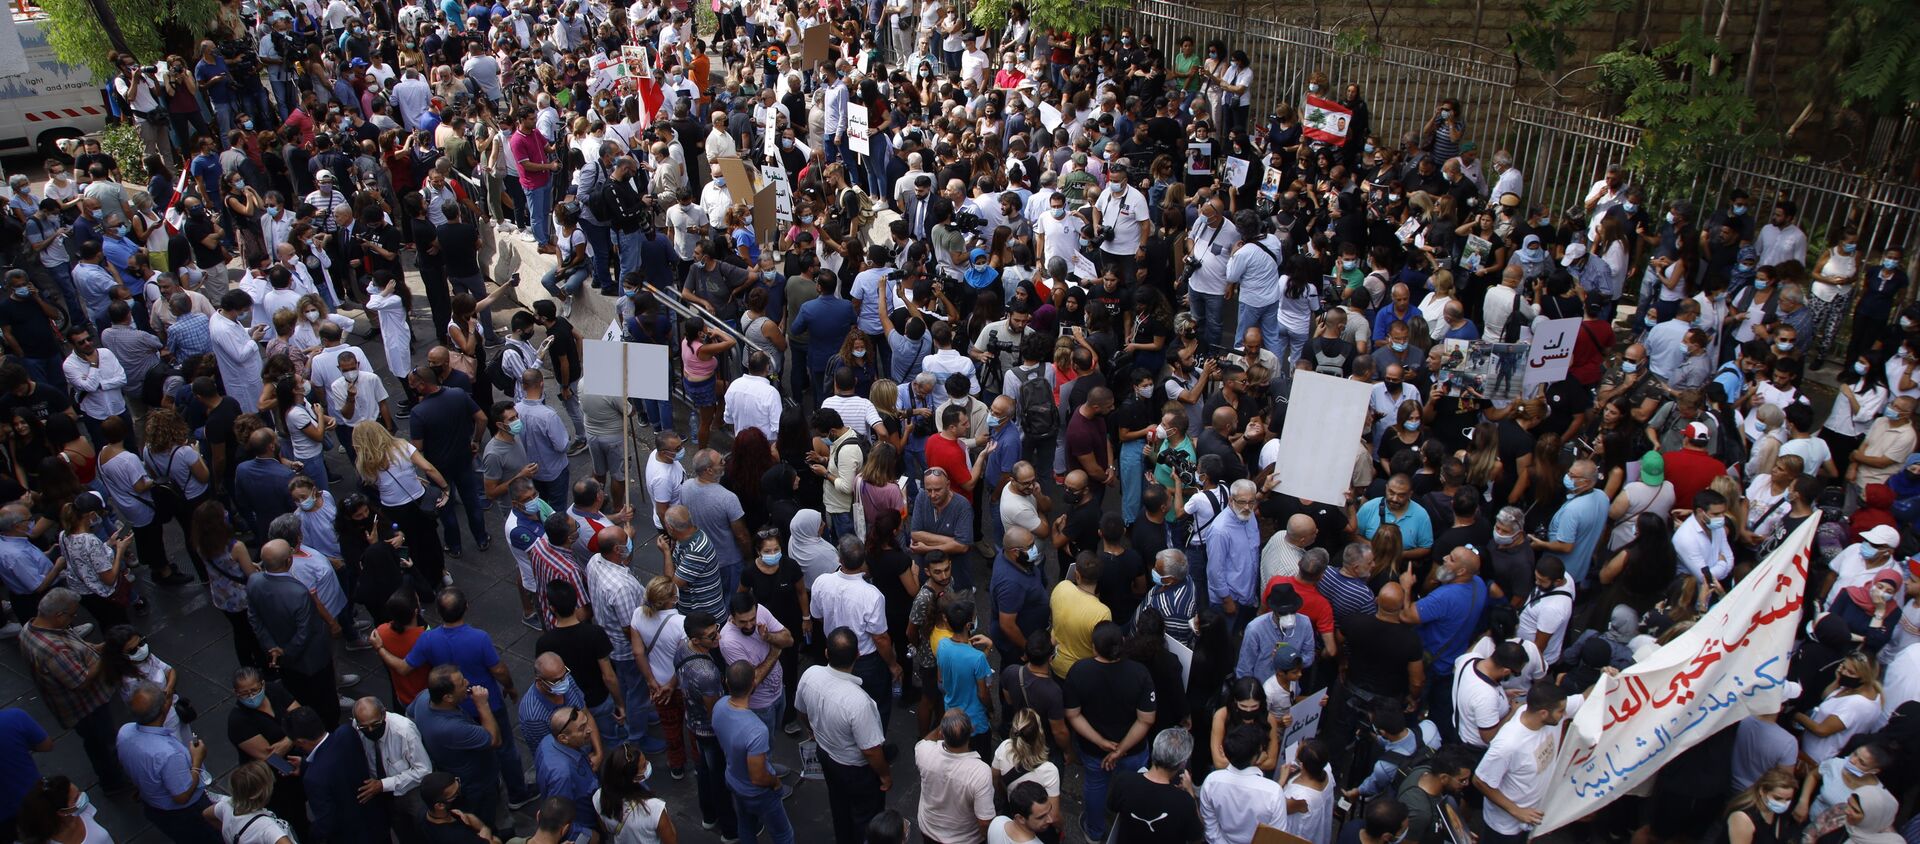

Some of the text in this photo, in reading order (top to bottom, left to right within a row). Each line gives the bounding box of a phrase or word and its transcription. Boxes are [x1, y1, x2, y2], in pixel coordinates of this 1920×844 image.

[26, 77, 44, 87] light
[46, 83, 62, 92] and
[1543, 331, 1565, 350] لن
